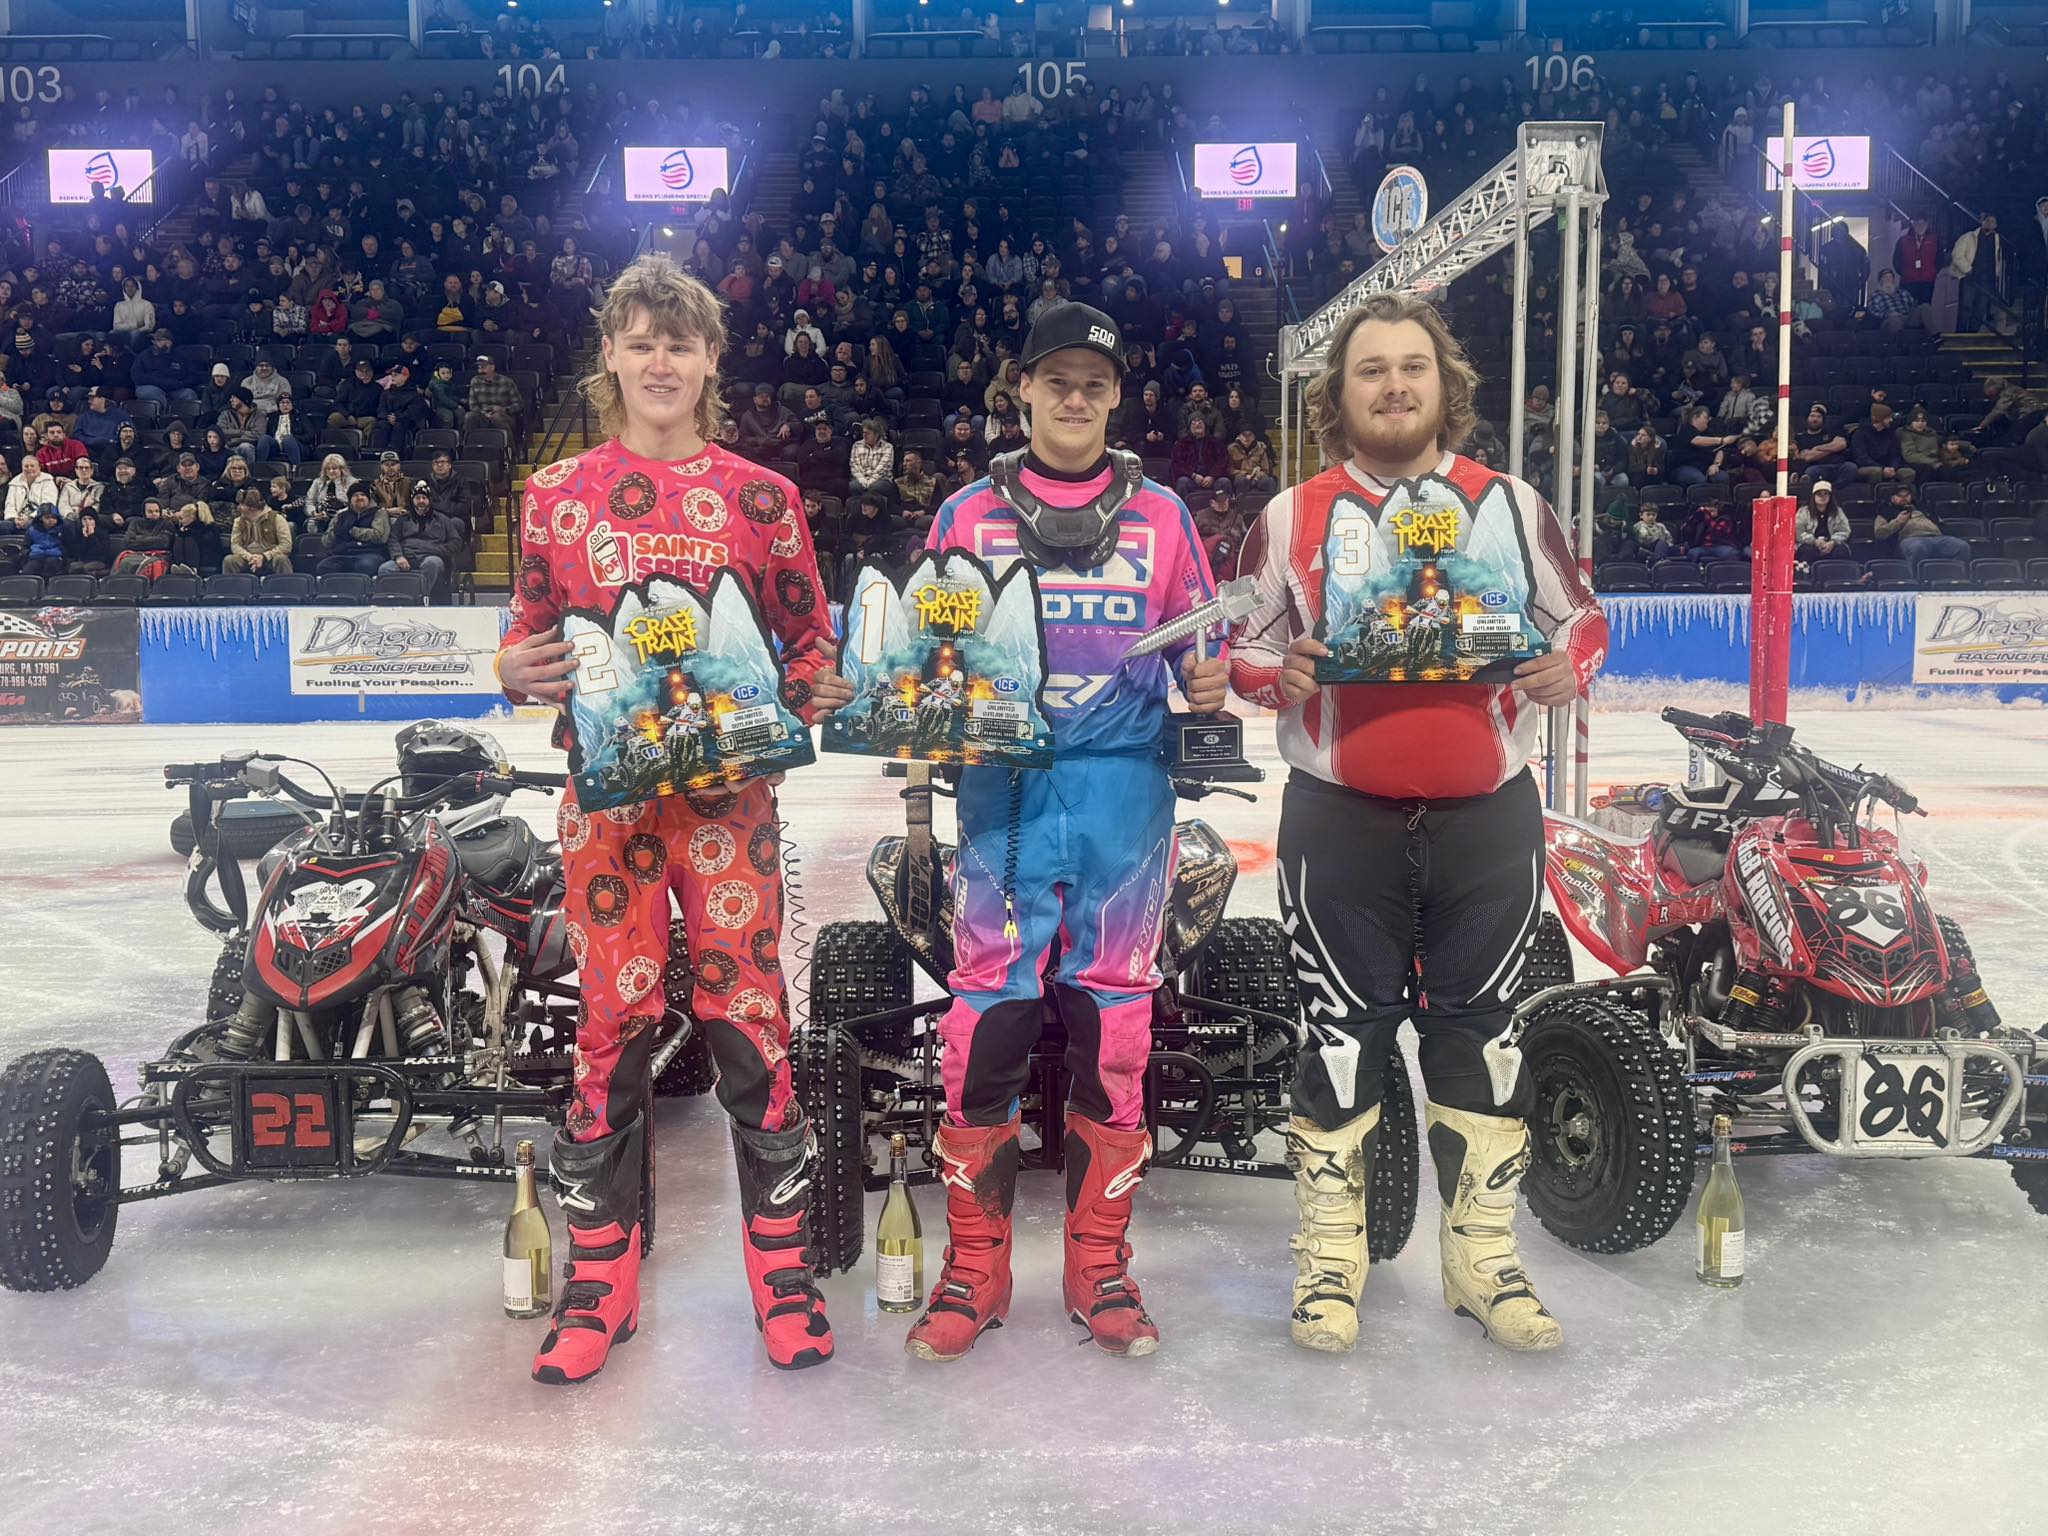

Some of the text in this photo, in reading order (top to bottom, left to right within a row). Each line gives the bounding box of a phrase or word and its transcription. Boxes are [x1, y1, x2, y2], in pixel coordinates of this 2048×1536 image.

[497, 63, 570, 100] 104
[1018, 61, 1088, 99] 105
[1525, 54, 1596, 92] 106
[1089, 324, 1116, 346] 500
[1388, 506, 1461, 531] CRAZY
[634, 533, 728, 566] SAINTS
[1332, 516, 1371, 576] 3
[1392, 526, 1458, 556] TRAIN
[911, 584, 984, 610] CRAZY
[1041, 593, 1137, 622] OTO
[1485, 593, 1503, 605] ICE
[622, 607, 698, 639] CRAZY
[859, 580, 889, 665] 1
[914, 603, 978, 634] TRAIN
[1926, 604, 2048, 647] Drago
[299, 614, 459, 658] Dragon
[629, 632, 698, 667] TRAIN
[20, 662, 33, 674] PA
[34, 662, 59, 674] 17961
[331, 661, 468, 674] RACING FUELS
[570, 630, 620, 695] 2
[1956, 652, 2030, 662] RACING
[0, 675, 48, 687] 70-968-4336
[306, 678, 474, 689] Fueling Your Passion...
[998, 679, 1015, 691] ICE
[1928, 667, 1985, 677] Fueling
[1985, 667, 2022, 676] Your
[736, 686, 756, 699] ICE
[734, 711, 764, 722] UNLIMITED
[986, 704, 1016, 712] UNLIMITED
[1004, 712, 1020, 720] QUAD
[1688, 749, 1698, 782] core
[1690, 810, 1750, 838] FX
[1560, 870, 1607, 901] makita
[1745, 868, 1795, 967] RACING
[1822, 885, 1908, 931] 86
[1187, 1025, 1238, 1035] RATH
[155, 1064, 195, 1074] RAT
[403, 1056, 457, 1066] RATH
[1859, 1053, 1950, 1150] 86
[251, 1092, 331, 1148] 22
